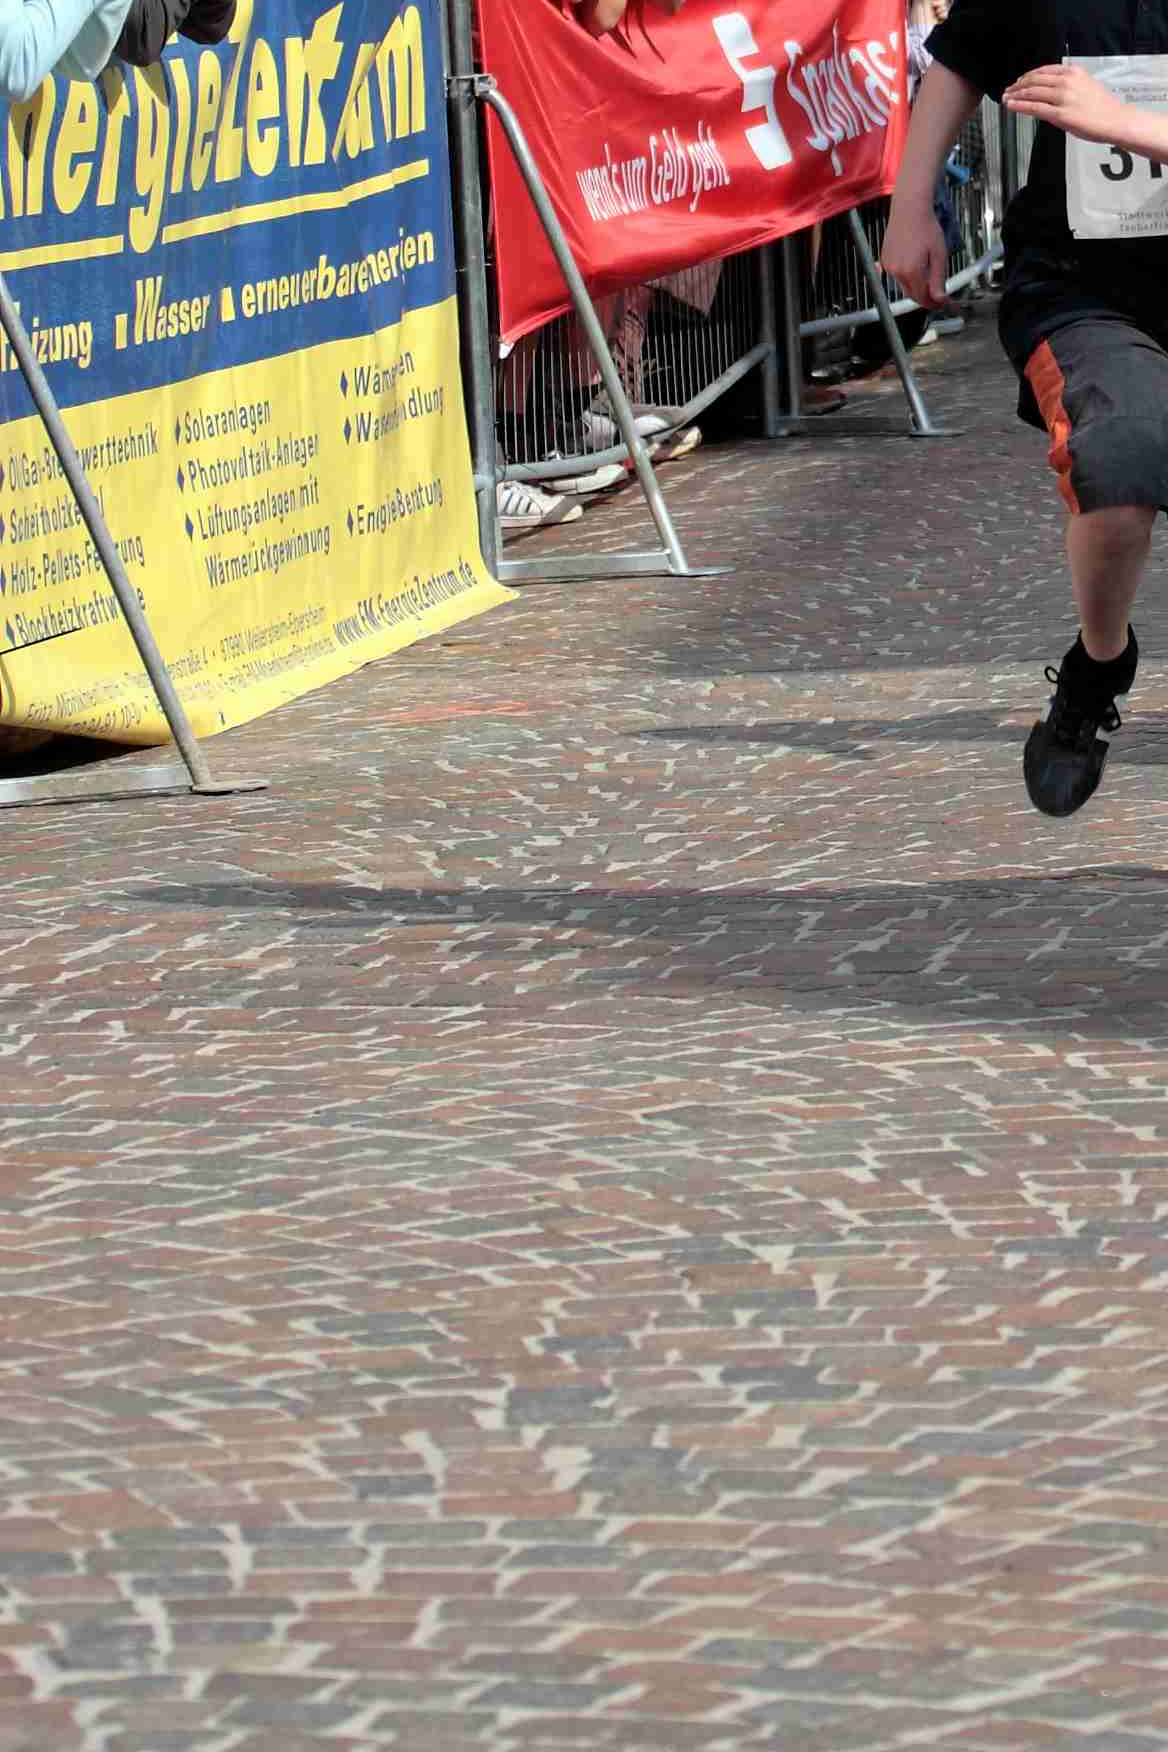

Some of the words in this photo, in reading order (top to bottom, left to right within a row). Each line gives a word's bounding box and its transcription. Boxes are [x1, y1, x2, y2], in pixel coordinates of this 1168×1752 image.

[621, 156, 649, 212] um
[134, 276, 210, 345] Wasser
[184, 399, 271, 444] Solaranlagen
